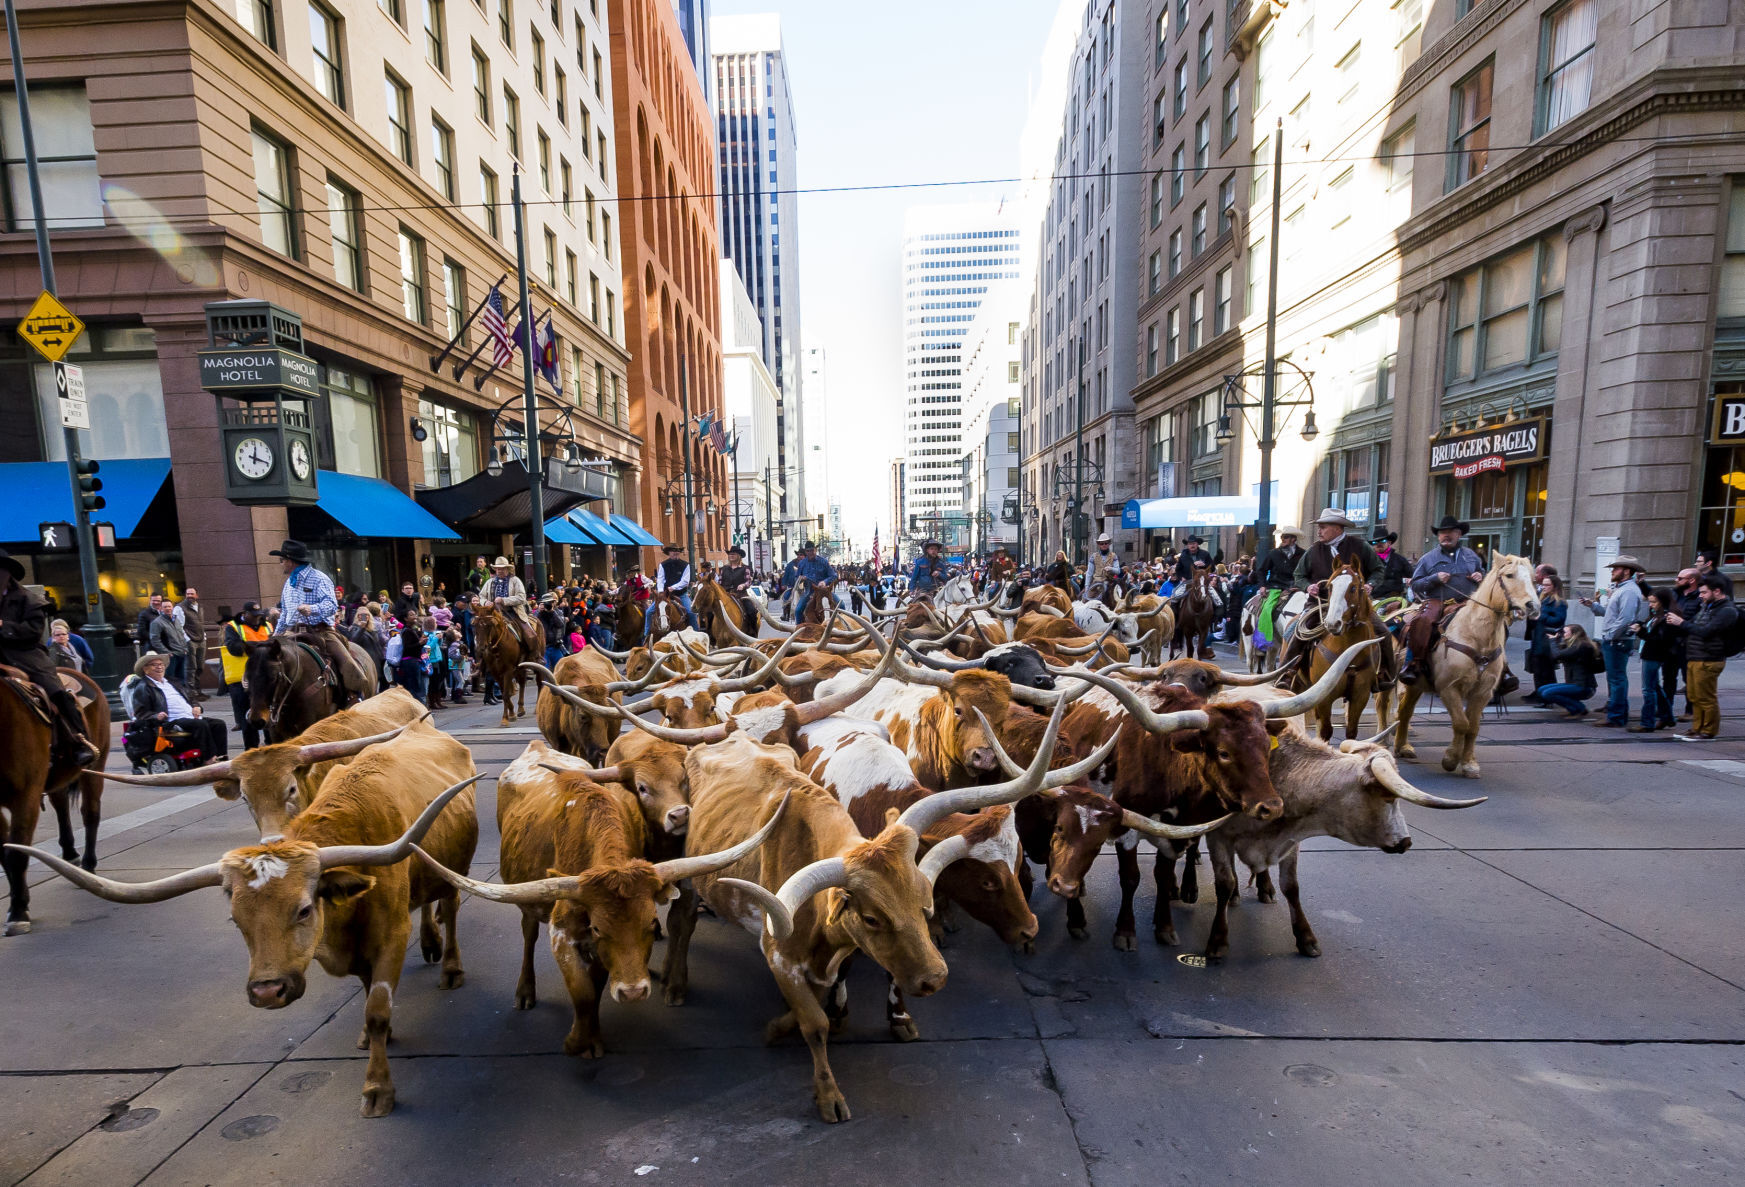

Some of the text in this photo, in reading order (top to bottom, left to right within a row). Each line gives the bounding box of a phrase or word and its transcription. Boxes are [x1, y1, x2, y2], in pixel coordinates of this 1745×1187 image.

[203, 356, 275, 369] MAGNOLIA
[281, 357, 317, 377] MAGNOLIA
[67, 377, 83, 388] TRAIN
[220, 370, 263, 381] HOTEL
[289, 373, 312, 388] HOTEL
[69, 388, 83, 398] ONLY
[1431, 427, 1537, 468] BRUEGGER'S BAGELS
[1454, 457, 1502, 477] BAKED FRESH
